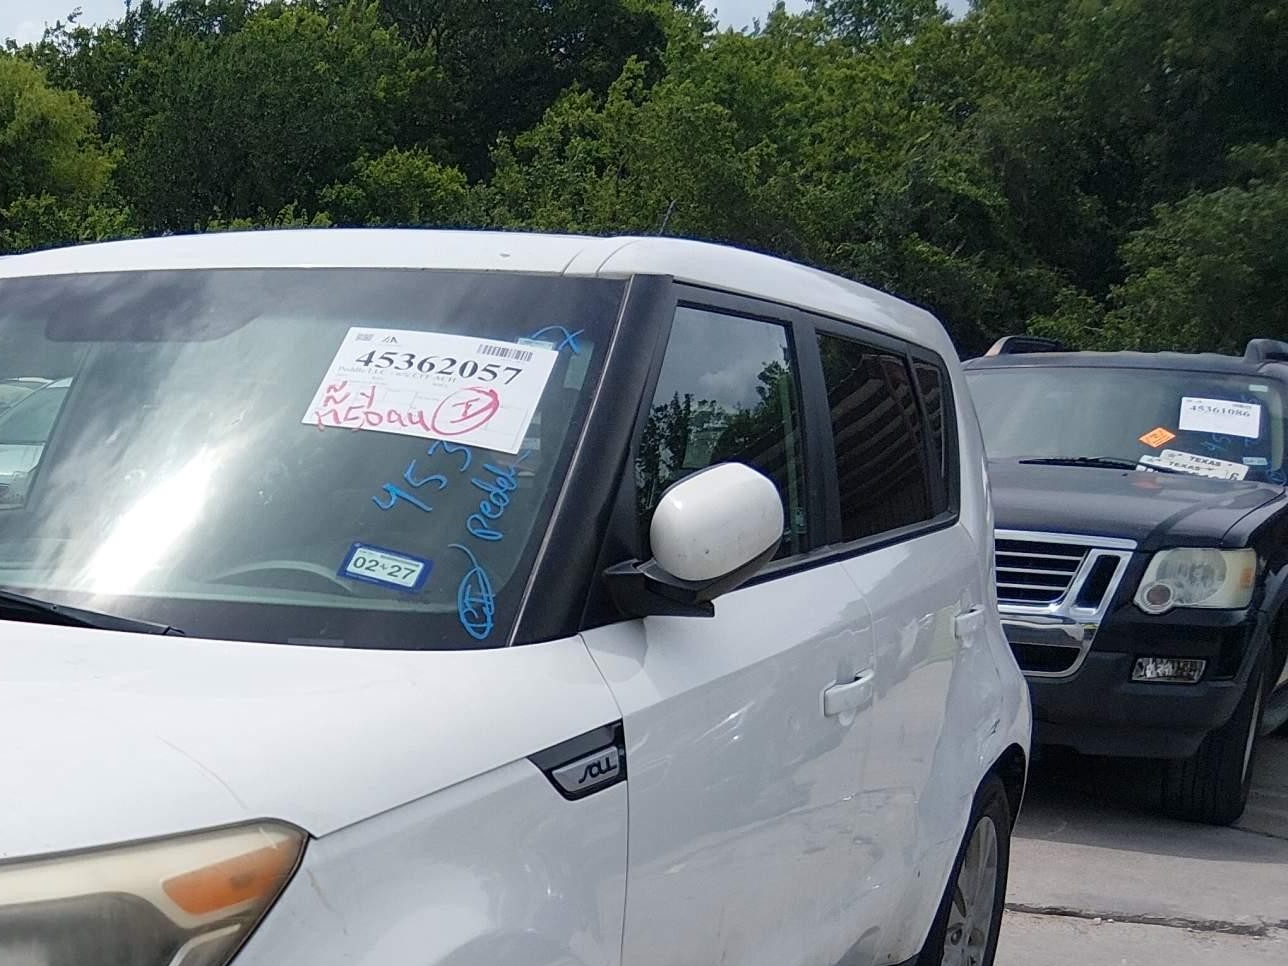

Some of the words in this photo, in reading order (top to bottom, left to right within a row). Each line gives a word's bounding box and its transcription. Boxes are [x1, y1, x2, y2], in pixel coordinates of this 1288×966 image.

[355, 350, 523, 385] 45362057
[1169, 461, 1201, 471] TEXAS
[1190, 456, 1222, 467] TEXAS
[353, 556, 379, 572] 02
[387, 564, 416, 580] 27
